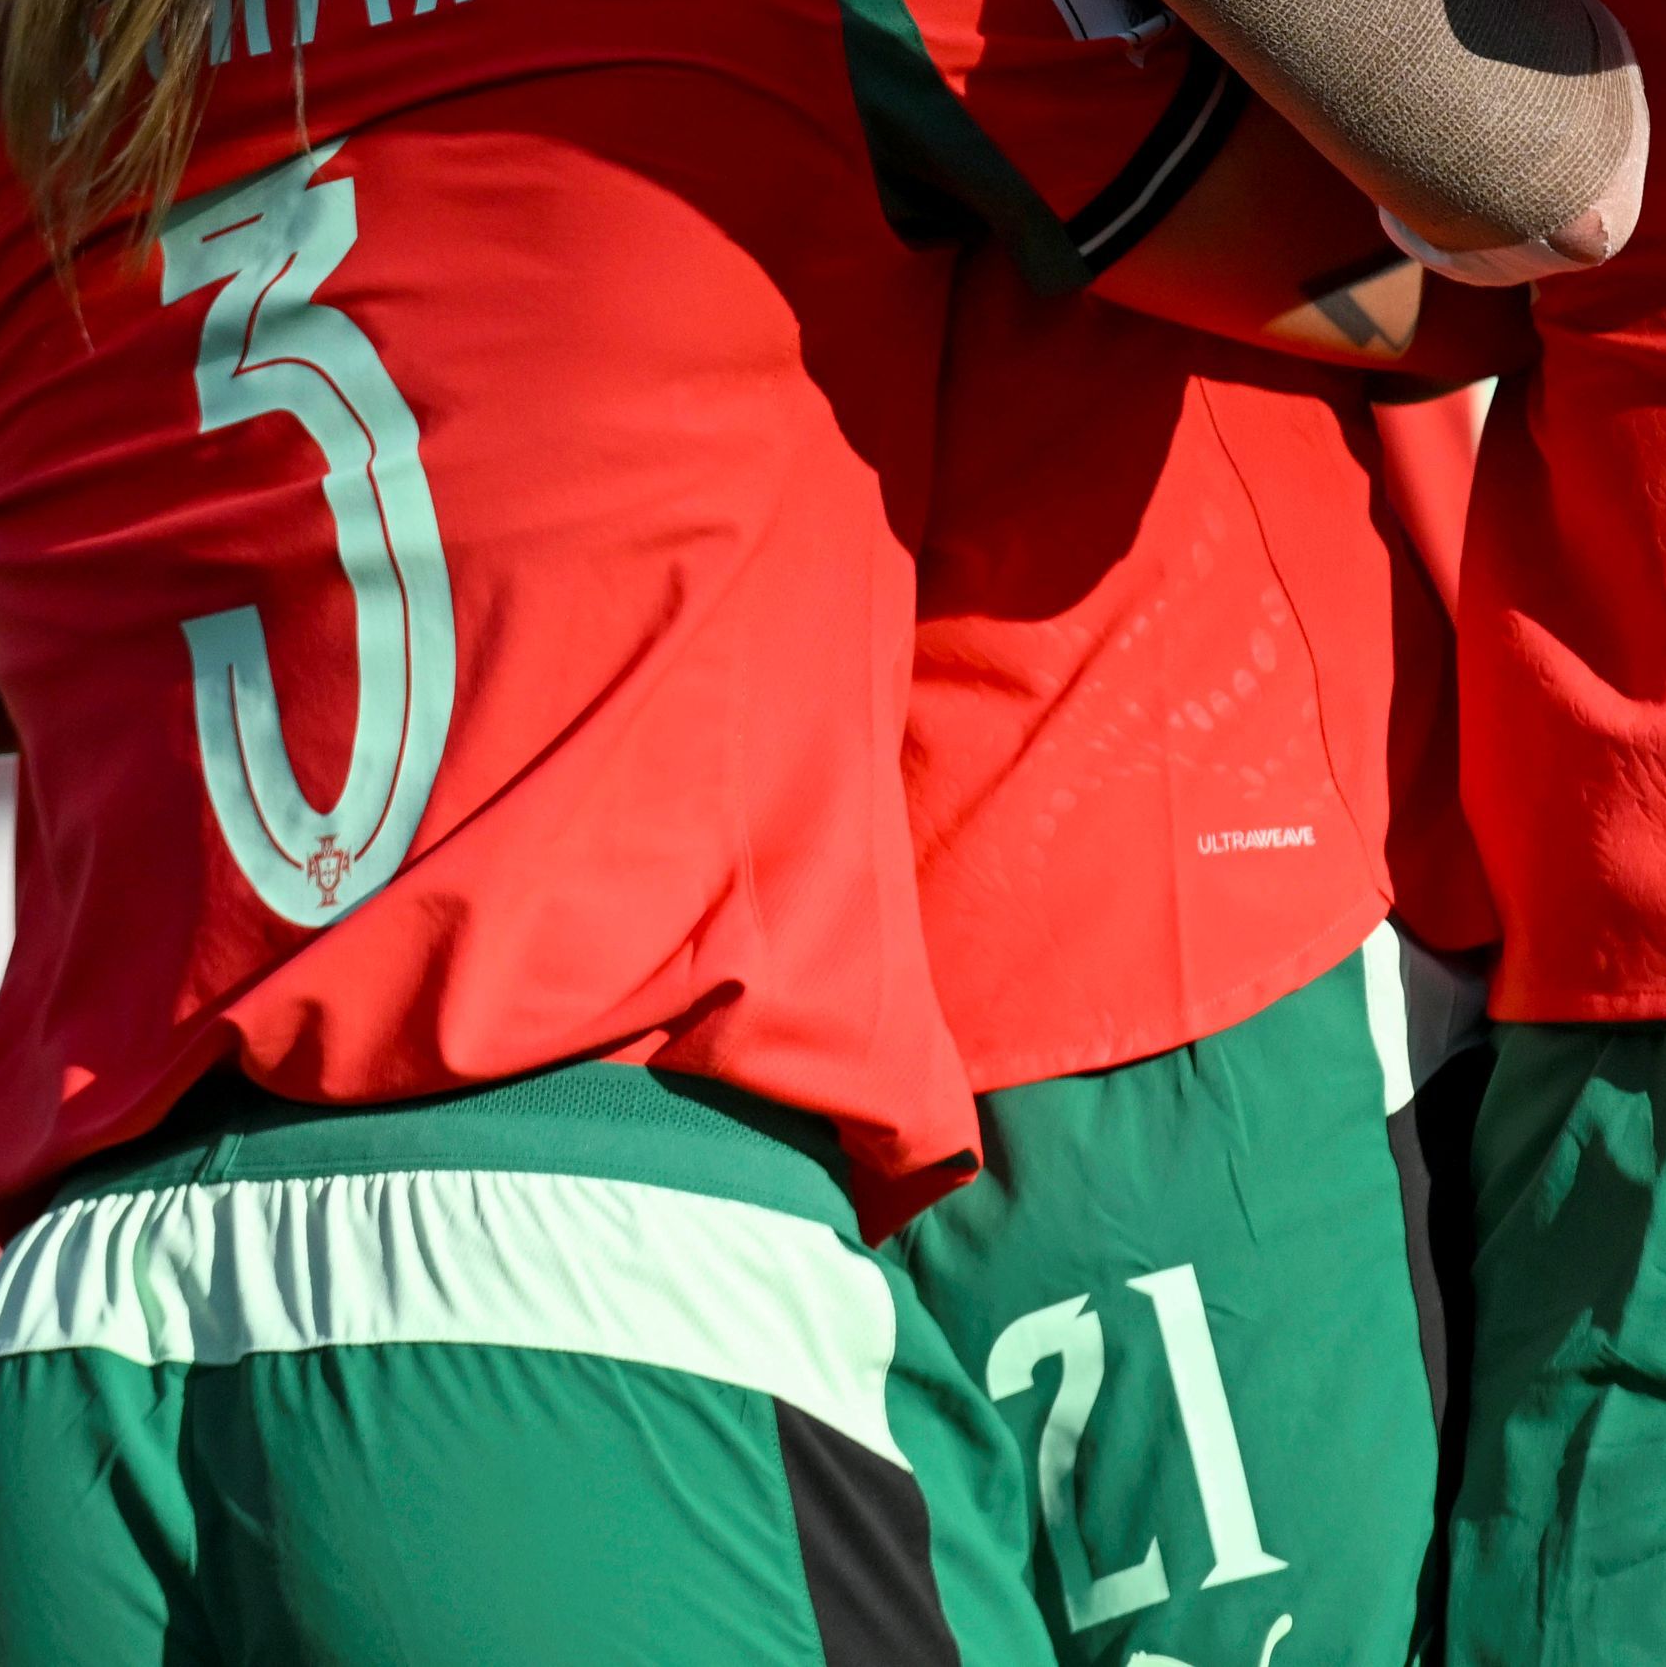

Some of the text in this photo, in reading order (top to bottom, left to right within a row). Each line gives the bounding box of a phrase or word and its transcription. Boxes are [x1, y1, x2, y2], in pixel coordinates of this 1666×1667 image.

[159, 134, 457, 929] 3
[1197, 826, 1316, 855] ULTRAWEAVE
[986, 1263, 1290, 1633] 21
